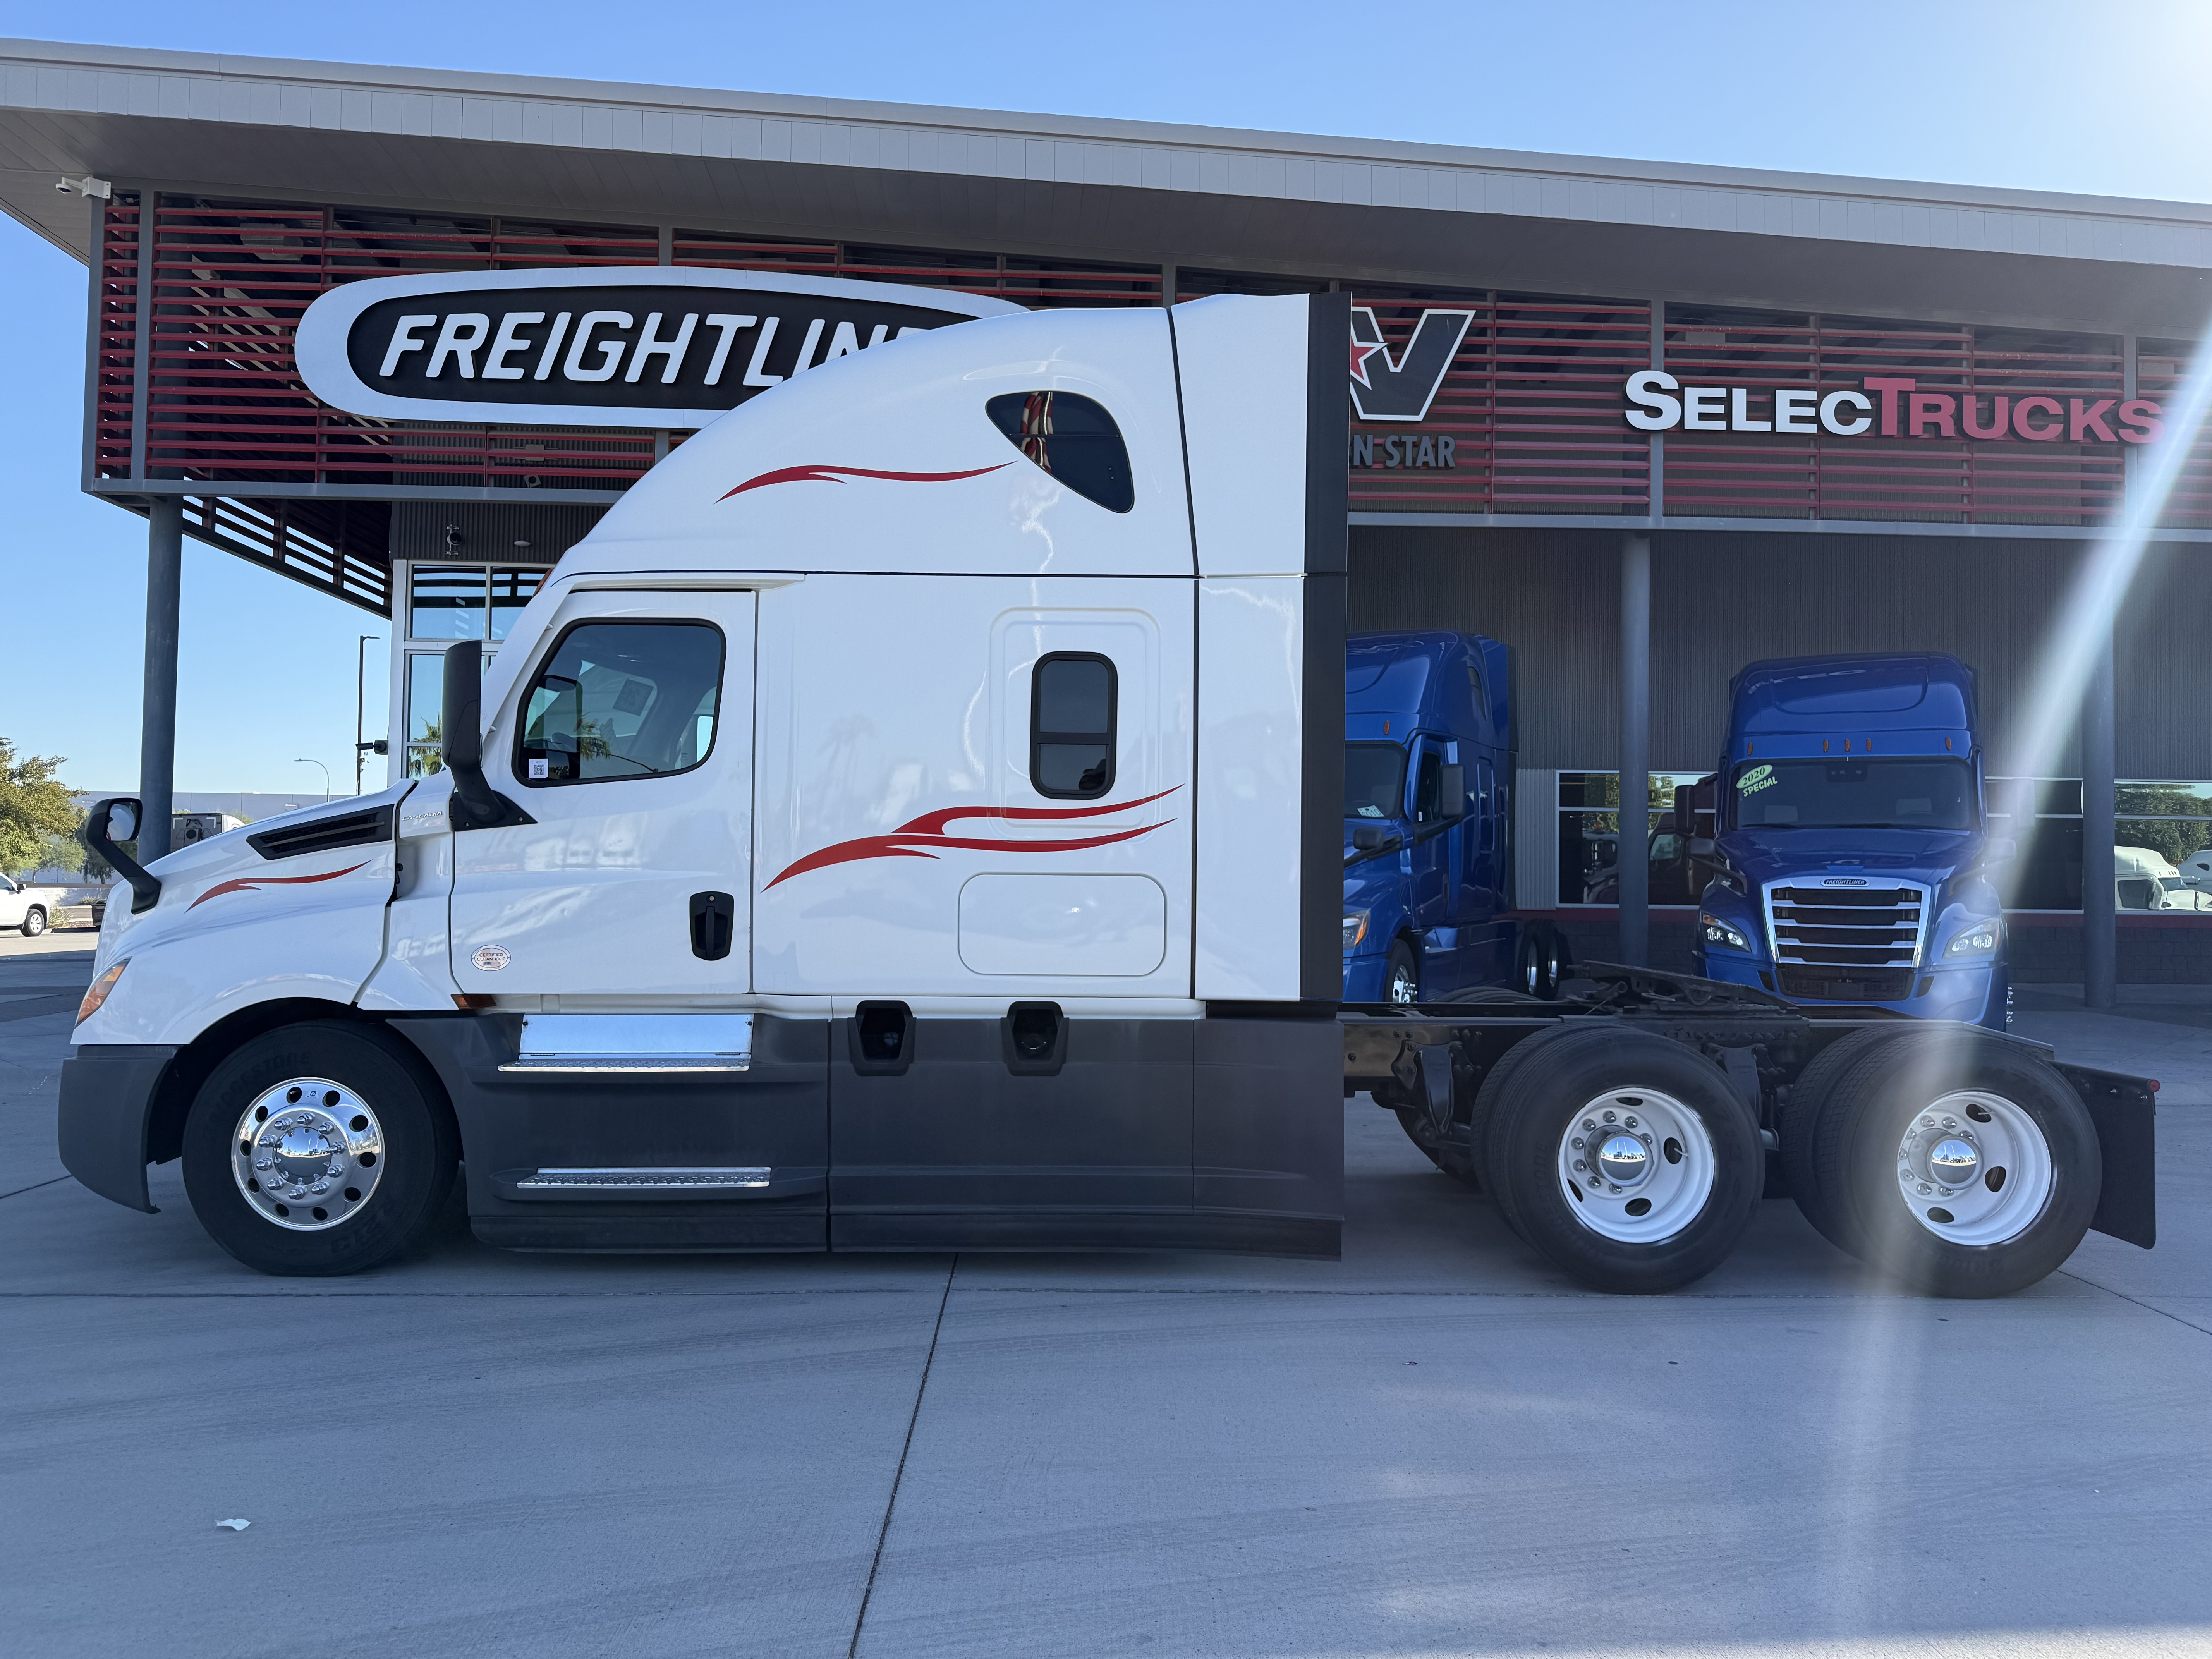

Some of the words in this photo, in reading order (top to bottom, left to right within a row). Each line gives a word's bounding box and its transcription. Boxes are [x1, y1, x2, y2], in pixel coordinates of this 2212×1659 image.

[380, 311, 929, 386] FREIGHTLI
[1384, 435, 1456, 467] STAR
[1743, 766, 1765, 786] 2020
[1743, 776, 1778, 797] SPECIAL
[402, 811, 443, 821] CASCADIA
